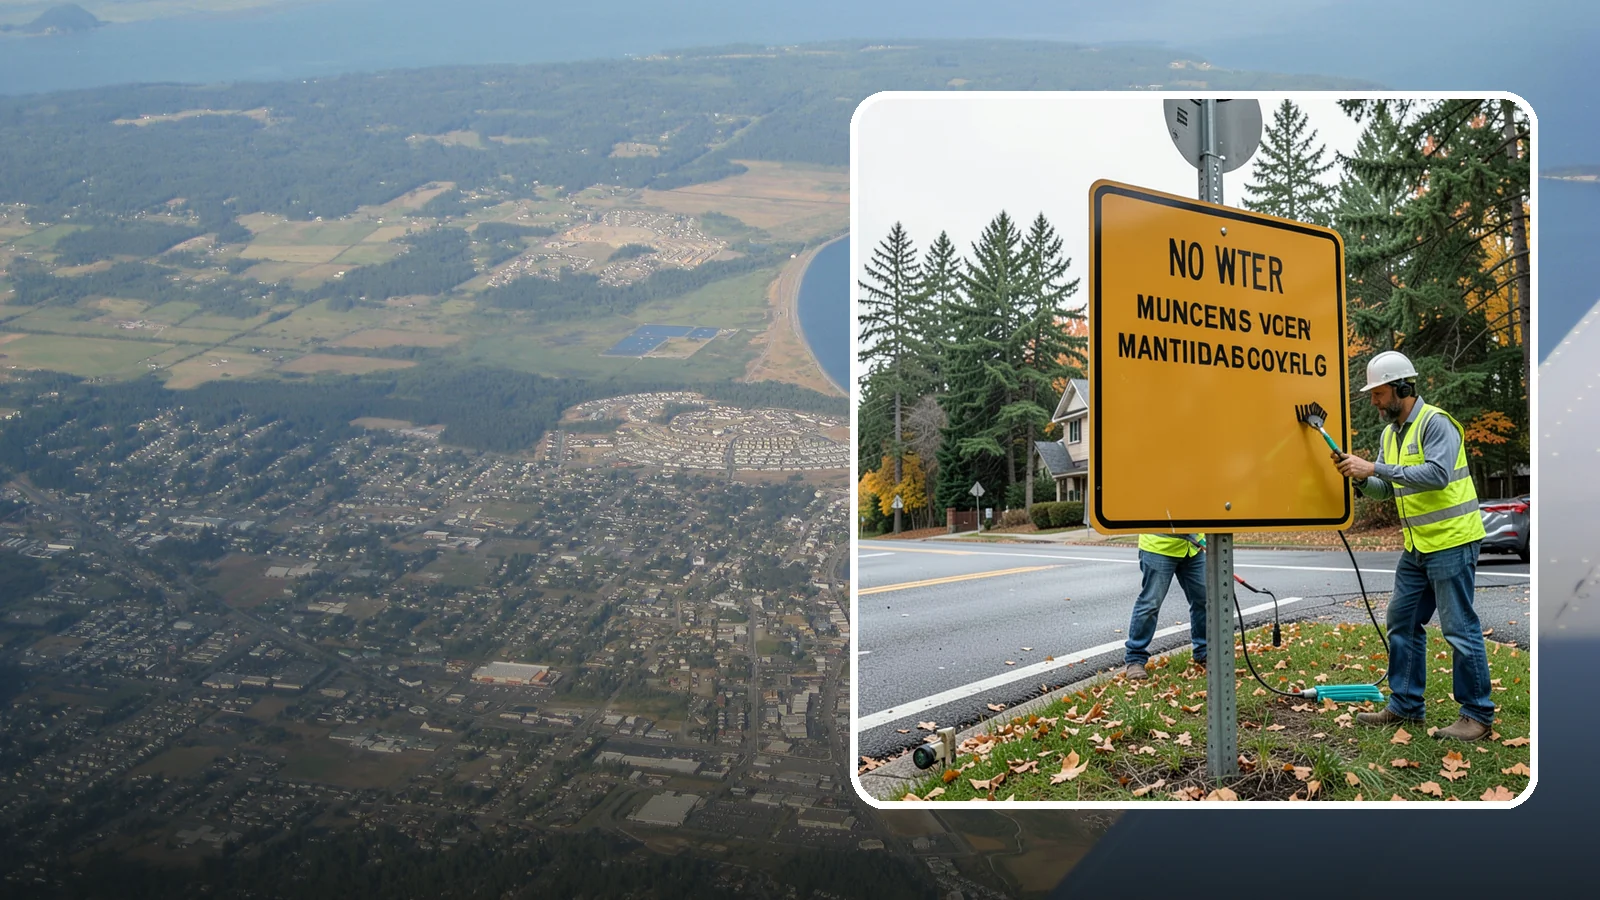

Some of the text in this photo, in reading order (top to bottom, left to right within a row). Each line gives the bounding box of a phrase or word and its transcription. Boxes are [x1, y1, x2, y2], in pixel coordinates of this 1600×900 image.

[1169, 237, 1284, 295] NO WTER
[1137, 293, 1252, 333] MUNCENS
